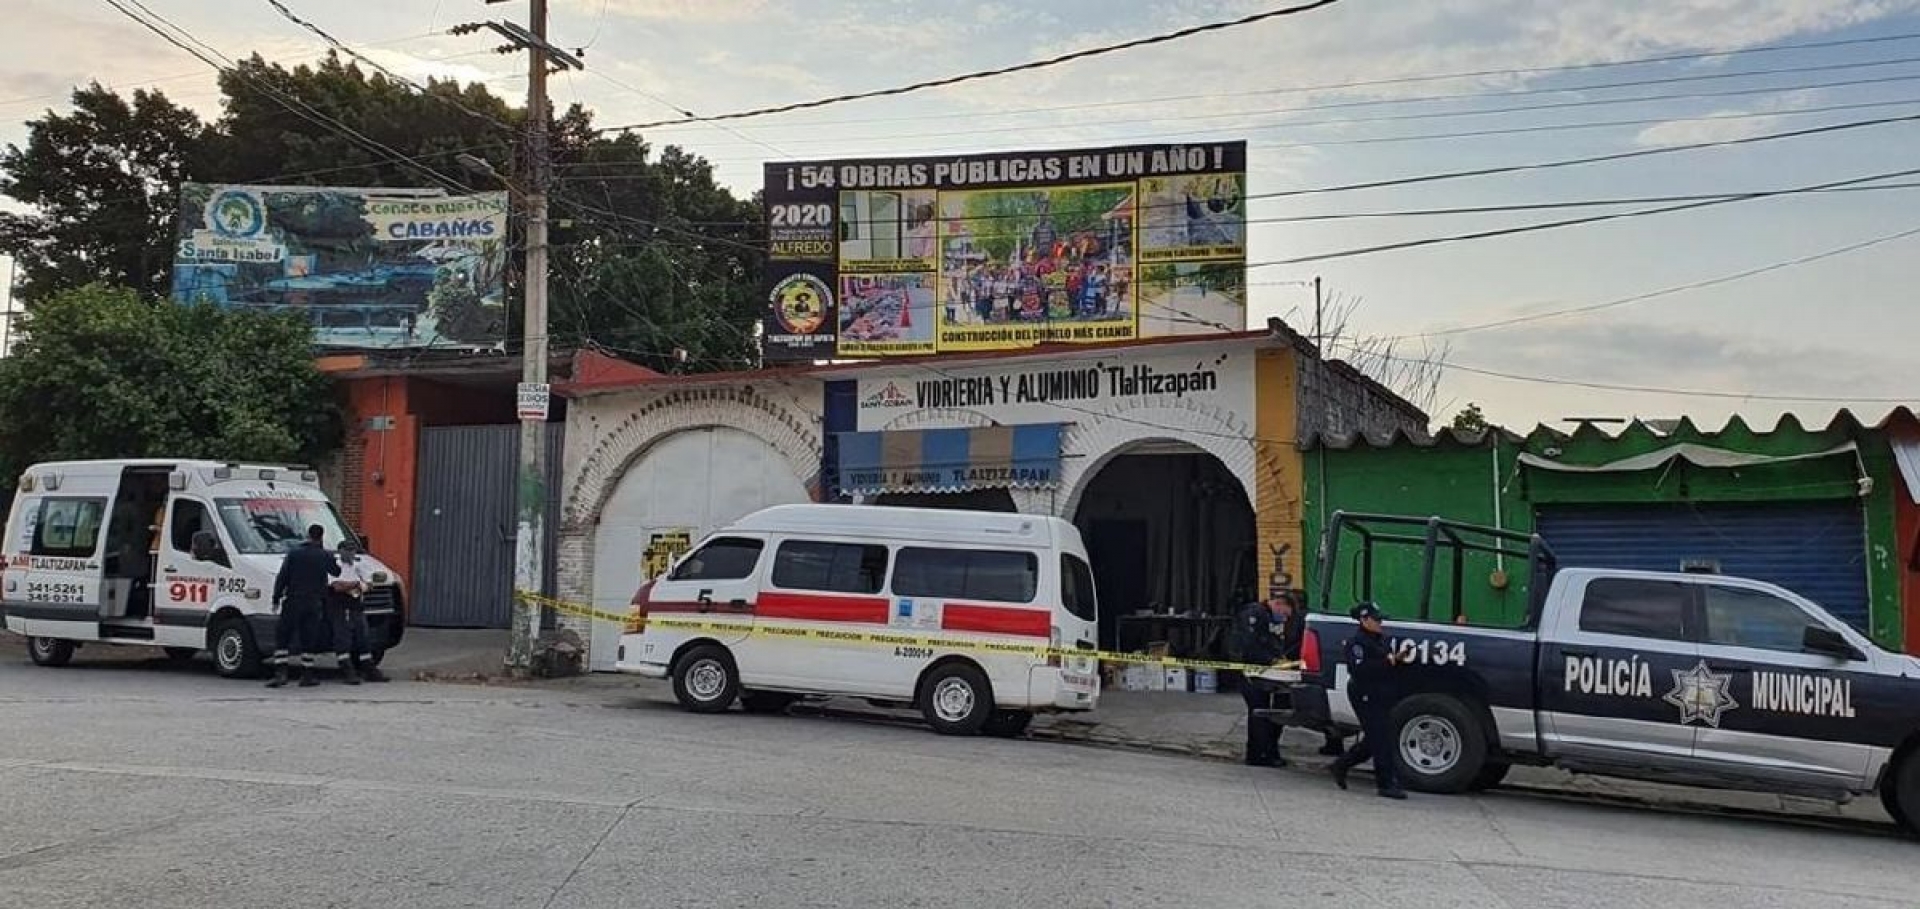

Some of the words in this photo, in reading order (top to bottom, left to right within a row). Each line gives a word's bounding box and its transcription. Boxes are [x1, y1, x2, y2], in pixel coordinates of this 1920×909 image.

[802, 164, 836, 188] 54
[841, 161, 927, 187] OBRAS
[934, 154, 1063, 185] PÚBLICAS
[1070, 156, 1100, 177] EN
[1106, 153, 1145, 176] UN
[1151, 146, 1206, 174] AÑO
[771, 204, 831, 227] 2020
[388, 217, 495, 239] CABAÑAS
[183, 241, 228, 259] Santa
[233, 247, 280, 260] Isabel
[770, 241, 832, 254] ALFREDO
[942, 328, 1014, 343] CONSTRUCCIÓN
[1015, 329, 1032, 340] DEL
[1073, 325, 1095, 339] MÁS
[1095, 325, 1132, 339] GRANDE
[916, 375, 994, 409] VIDRIERIA
[998, 374, 1011, 404] Y
[1015, 369, 1099, 403] ALUMINIO
[27, 582, 84, 595] 341-5261
[169, 582, 208, 603] 911
[218, 576, 247, 593] R-052
[697, 588, 712, 614] 5
[1565, 653, 1653, 698] POLICÍA
[1751, 670, 1857, 719] MUNICIPAL
